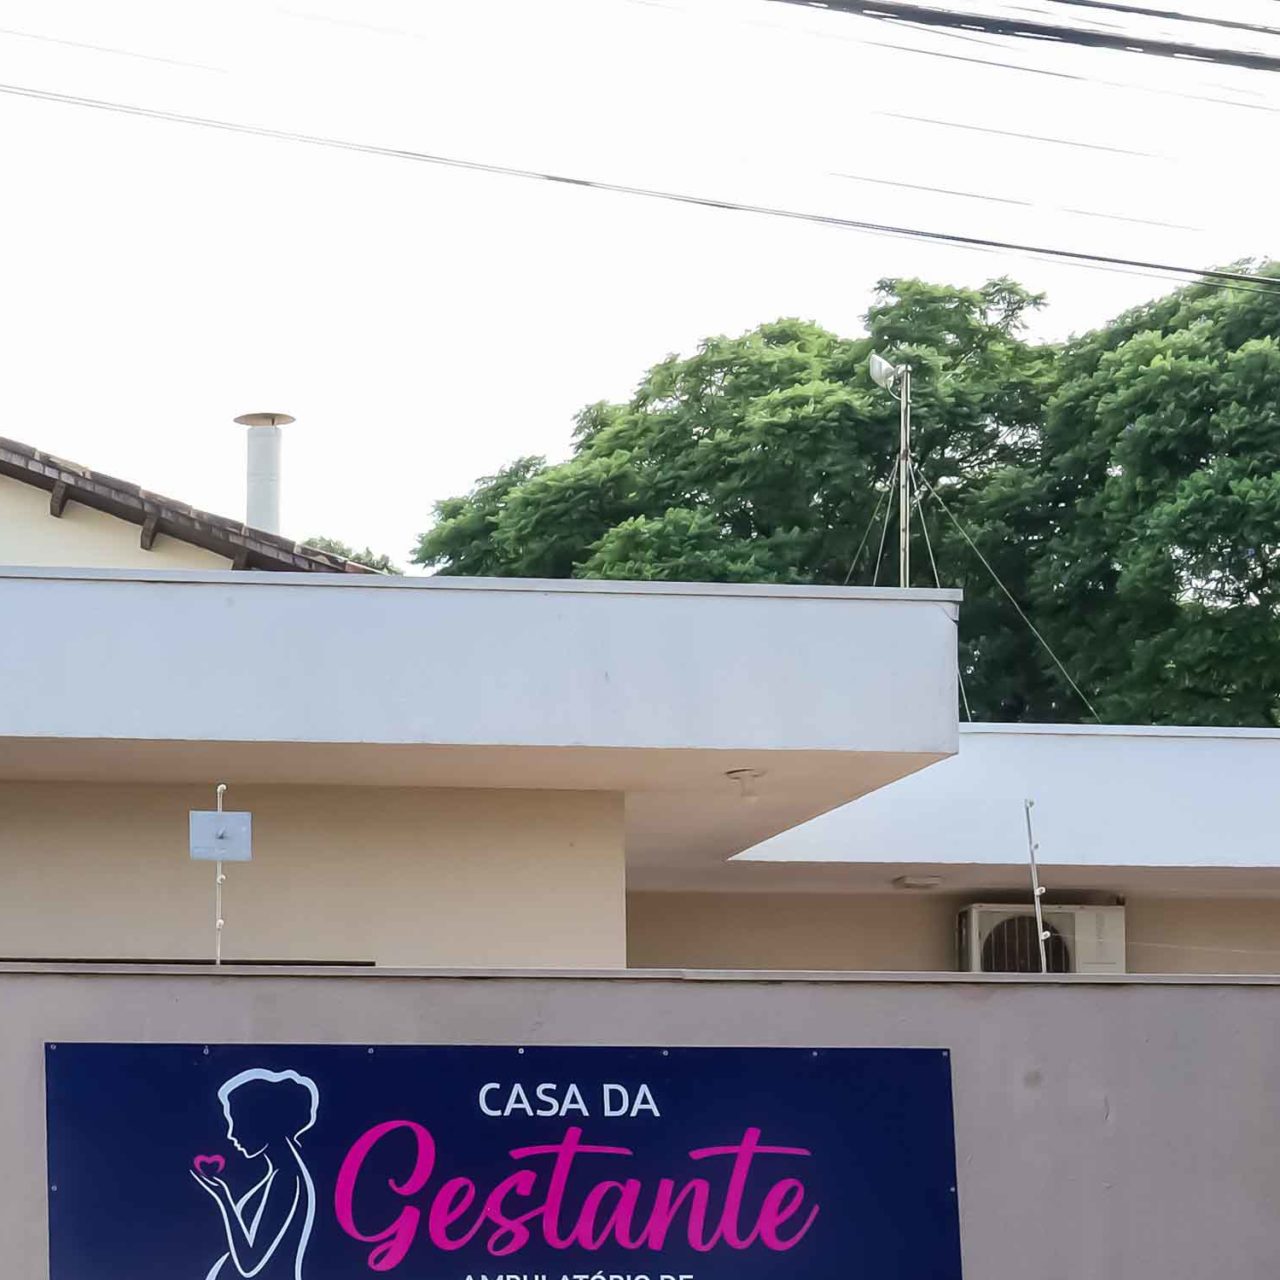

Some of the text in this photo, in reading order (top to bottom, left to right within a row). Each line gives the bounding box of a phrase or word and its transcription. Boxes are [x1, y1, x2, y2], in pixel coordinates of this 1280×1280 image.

[478, 1082, 661, 1117] CASA DA
[334, 1120, 820, 1271] Gestante
